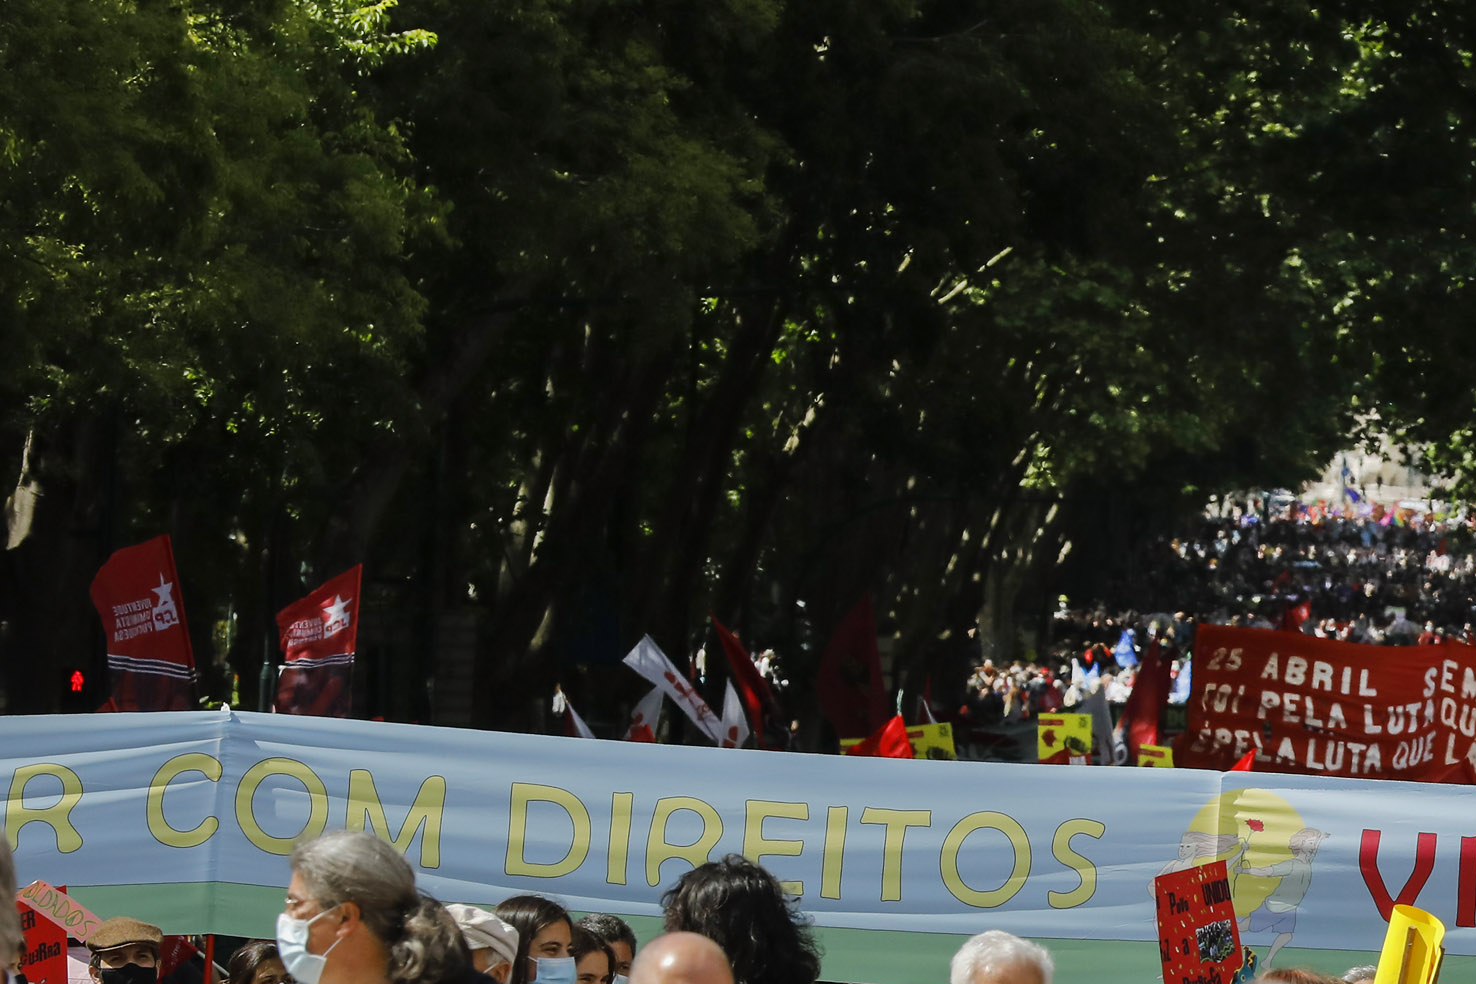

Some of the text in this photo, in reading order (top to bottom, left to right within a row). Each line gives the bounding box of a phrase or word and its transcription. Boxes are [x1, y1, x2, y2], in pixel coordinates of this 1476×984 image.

[1206, 647, 1244, 671] 25
[1261, 652, 1377, 697] ABRIL
[1257, 691, 1347, 729] PELA
[1364, 699, 1435, 735] LUTA
[1213, 727, 1297, 767] PELA
[1305, 737, 1383, 774] LUTA
[1391, 730, 1437, 771] QUE
[146, 751, 447, 870] COM
[504, 781, 1106, 910] DIREITOS
[1201, 878, 1232, 906] UNIDO
